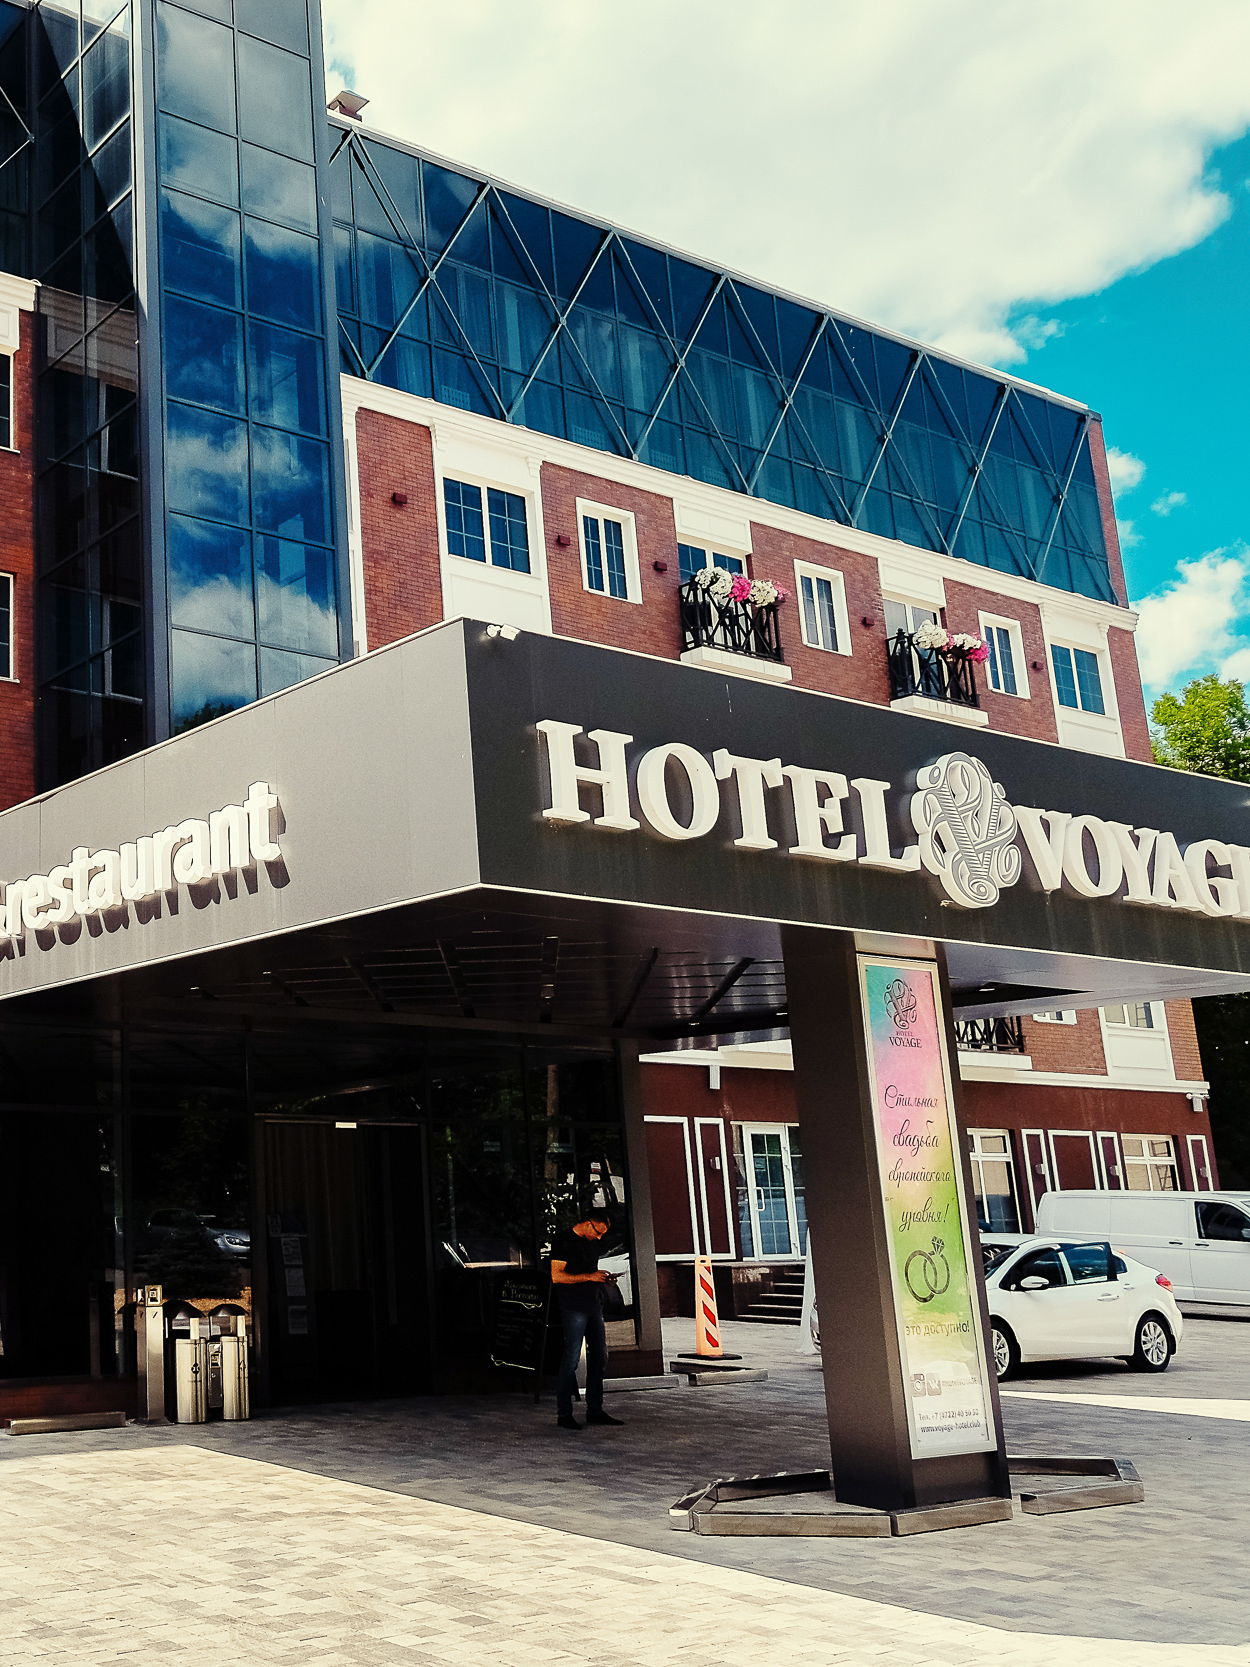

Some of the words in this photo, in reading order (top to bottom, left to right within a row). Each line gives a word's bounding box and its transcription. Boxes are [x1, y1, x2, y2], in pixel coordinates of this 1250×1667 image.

[536, 719, 920, 872] HOTEL
[889, 1036, 922, 1048] VOYAGE
[884, 1084, 939, 1109] Стильная
[892, 1119, 939, 1157] свадьба
[888, 1157, 951, 1188] европейского
[898, 1196, 950, 1232] уровня!
[905, 1324, 921, 1336] это
[923, 1320, 970, 1337] доступно!
